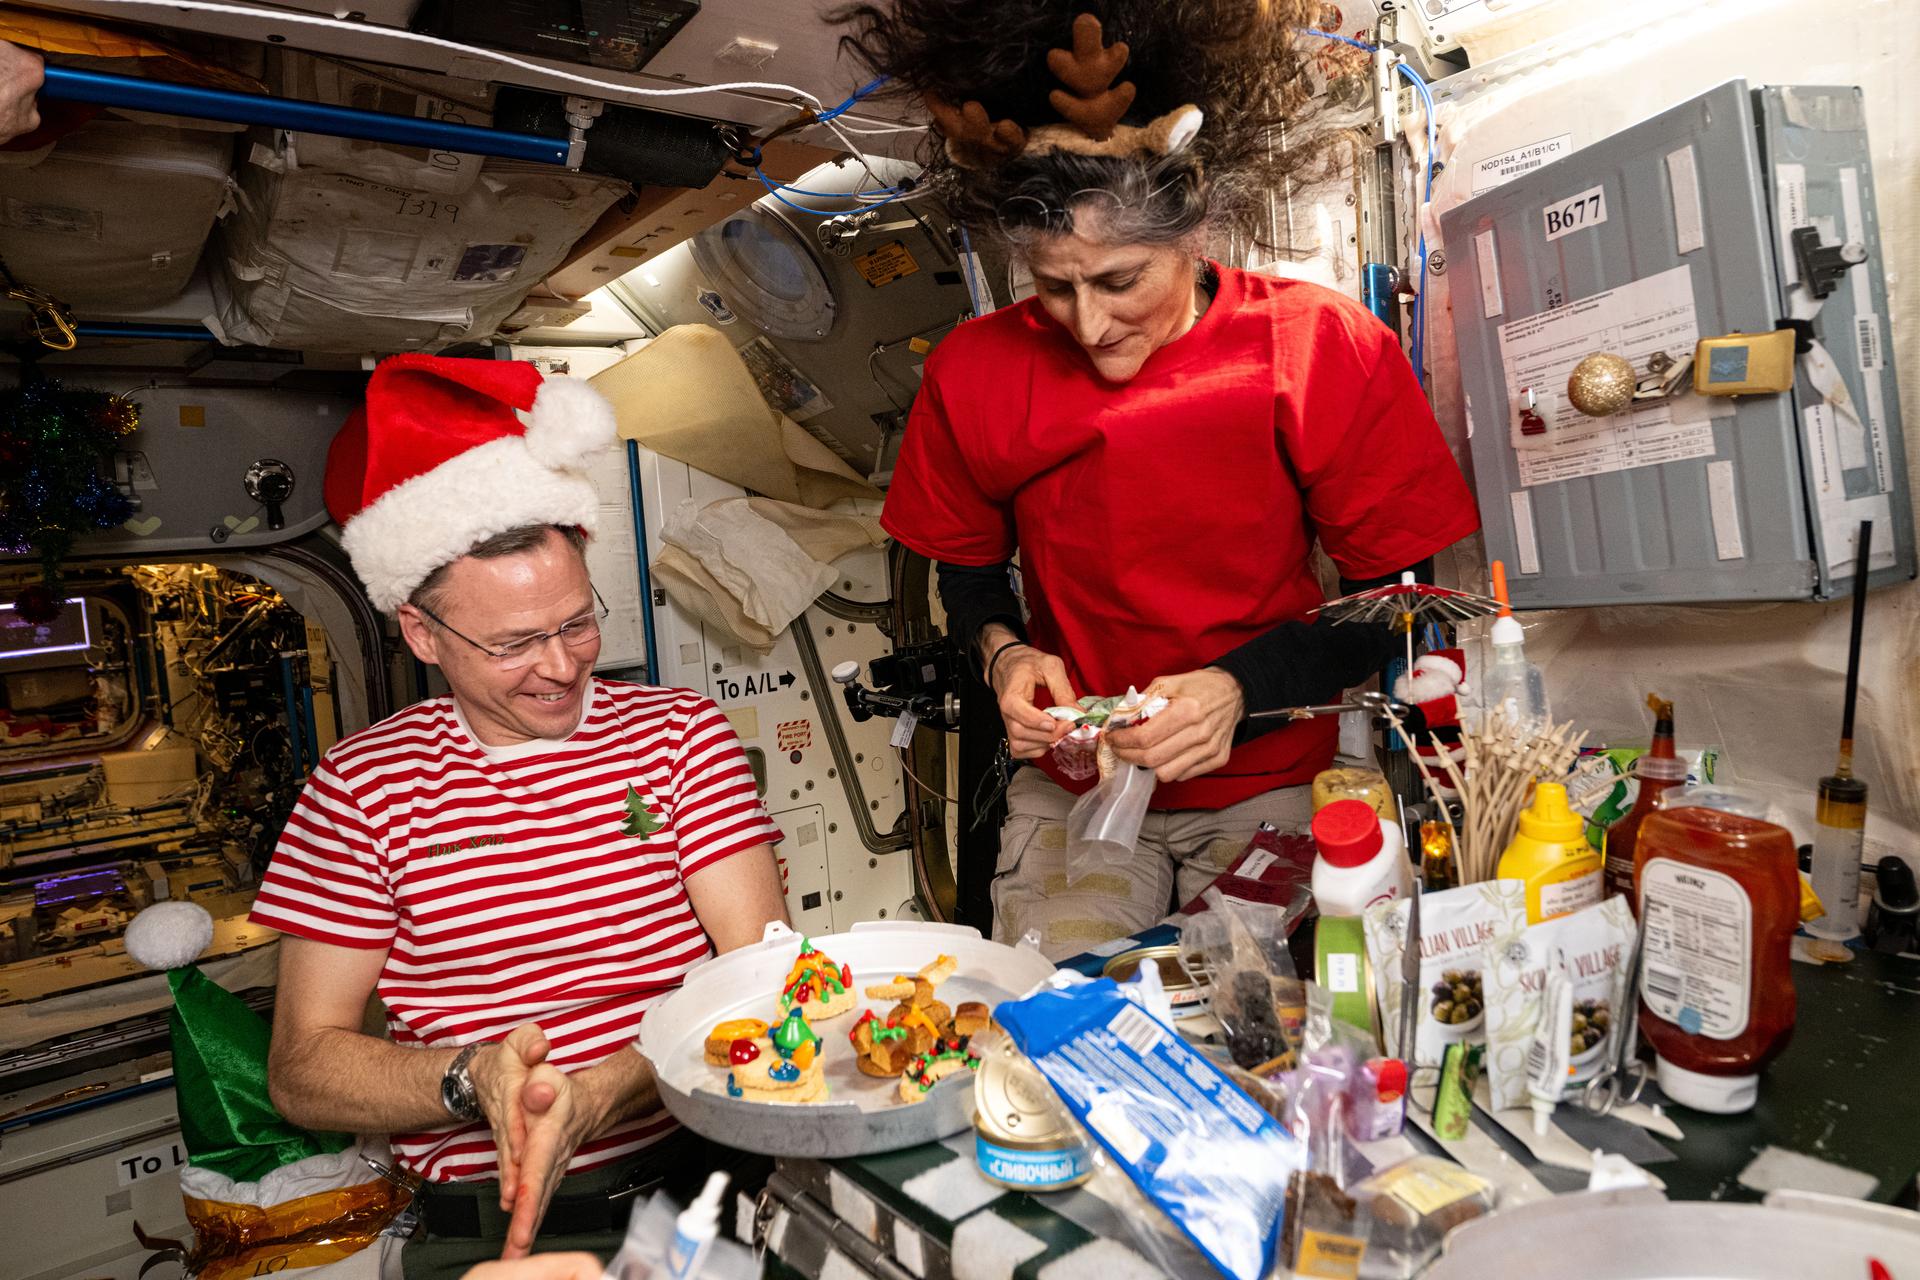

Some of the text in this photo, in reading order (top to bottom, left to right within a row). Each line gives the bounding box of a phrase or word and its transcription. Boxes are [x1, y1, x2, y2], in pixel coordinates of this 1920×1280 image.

[1480, 142, 1561, 172] NOD1S4_A1/B1/C1
[396, 197, 459, 224] 1319
[717, 671, 778, 701] To A/L
[121, 1152, 161, 1182] To
